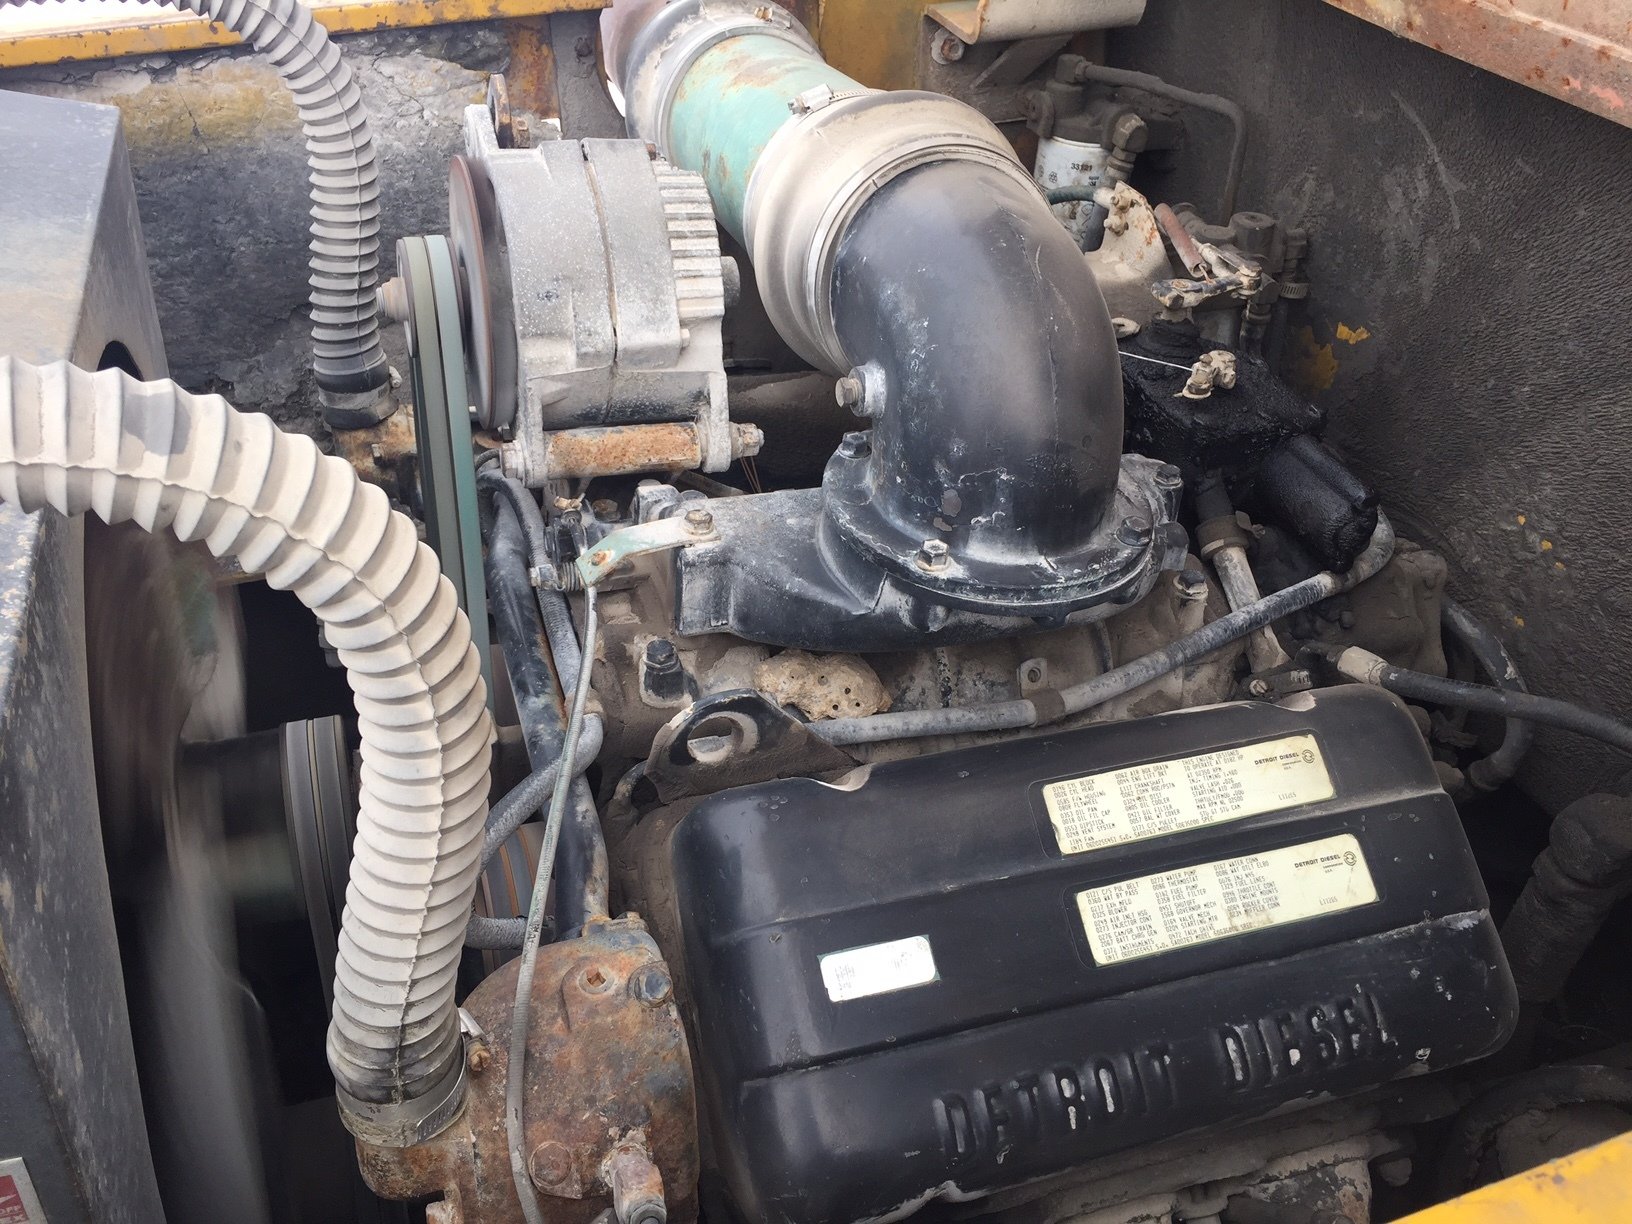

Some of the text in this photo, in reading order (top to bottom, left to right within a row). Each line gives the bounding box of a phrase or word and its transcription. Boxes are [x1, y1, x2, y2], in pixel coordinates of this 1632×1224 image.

[1254, 756, 1278, 765] DETROIT
[1279, 752, 1299, 760] DIESEL
[1152, 797, 1171, 806] COOLER
[1154, 804, 1173, 813] FILTER
[1165, 809, 1181, 817] COVER
[1228, 859, 1244, 868] WATER
[1294, 859, 1319, 868] DETROIT
[1320, 854, 1341, 863] DIESEL
[1165, 873, 1182, 881] WATER
[1183, 869, 1196, 877] PUMP
[1167, 876, 1199, 888] THERMOSTAT
[1235, 875, 1266, 887] FUEL LINES
[1125, 889, 1139, 897] PASS
[1170, 884, 1199, 895] FUEL PUMP
[1237, 881, 1276, 895] THROTTLE CONT
[1172, 893, 1186, 901] FUEL
[1188, 888, 1207, 897] FILTER
[1239, 887, 1278, 901] ENGINE MOUNTS
[1263, 895, 1279, 903] COVER
[1108, 906, 1128, 915] BLOWER
[1176, 904, 1202, 915] GOVERNOR
[1111, 918, 1137, 930] INJECTOR
[1139, 915, 1152, 923] CONT
[1178, 914, 1195, 923] VALVE
[1181, 918, 1206, 929] STARTING
[1136, 923, 1152, 932] TRAIN
[1116, 935, 1129, 944] BATT
[932, 983, 1398, 1160] DETROIT DIESEL
